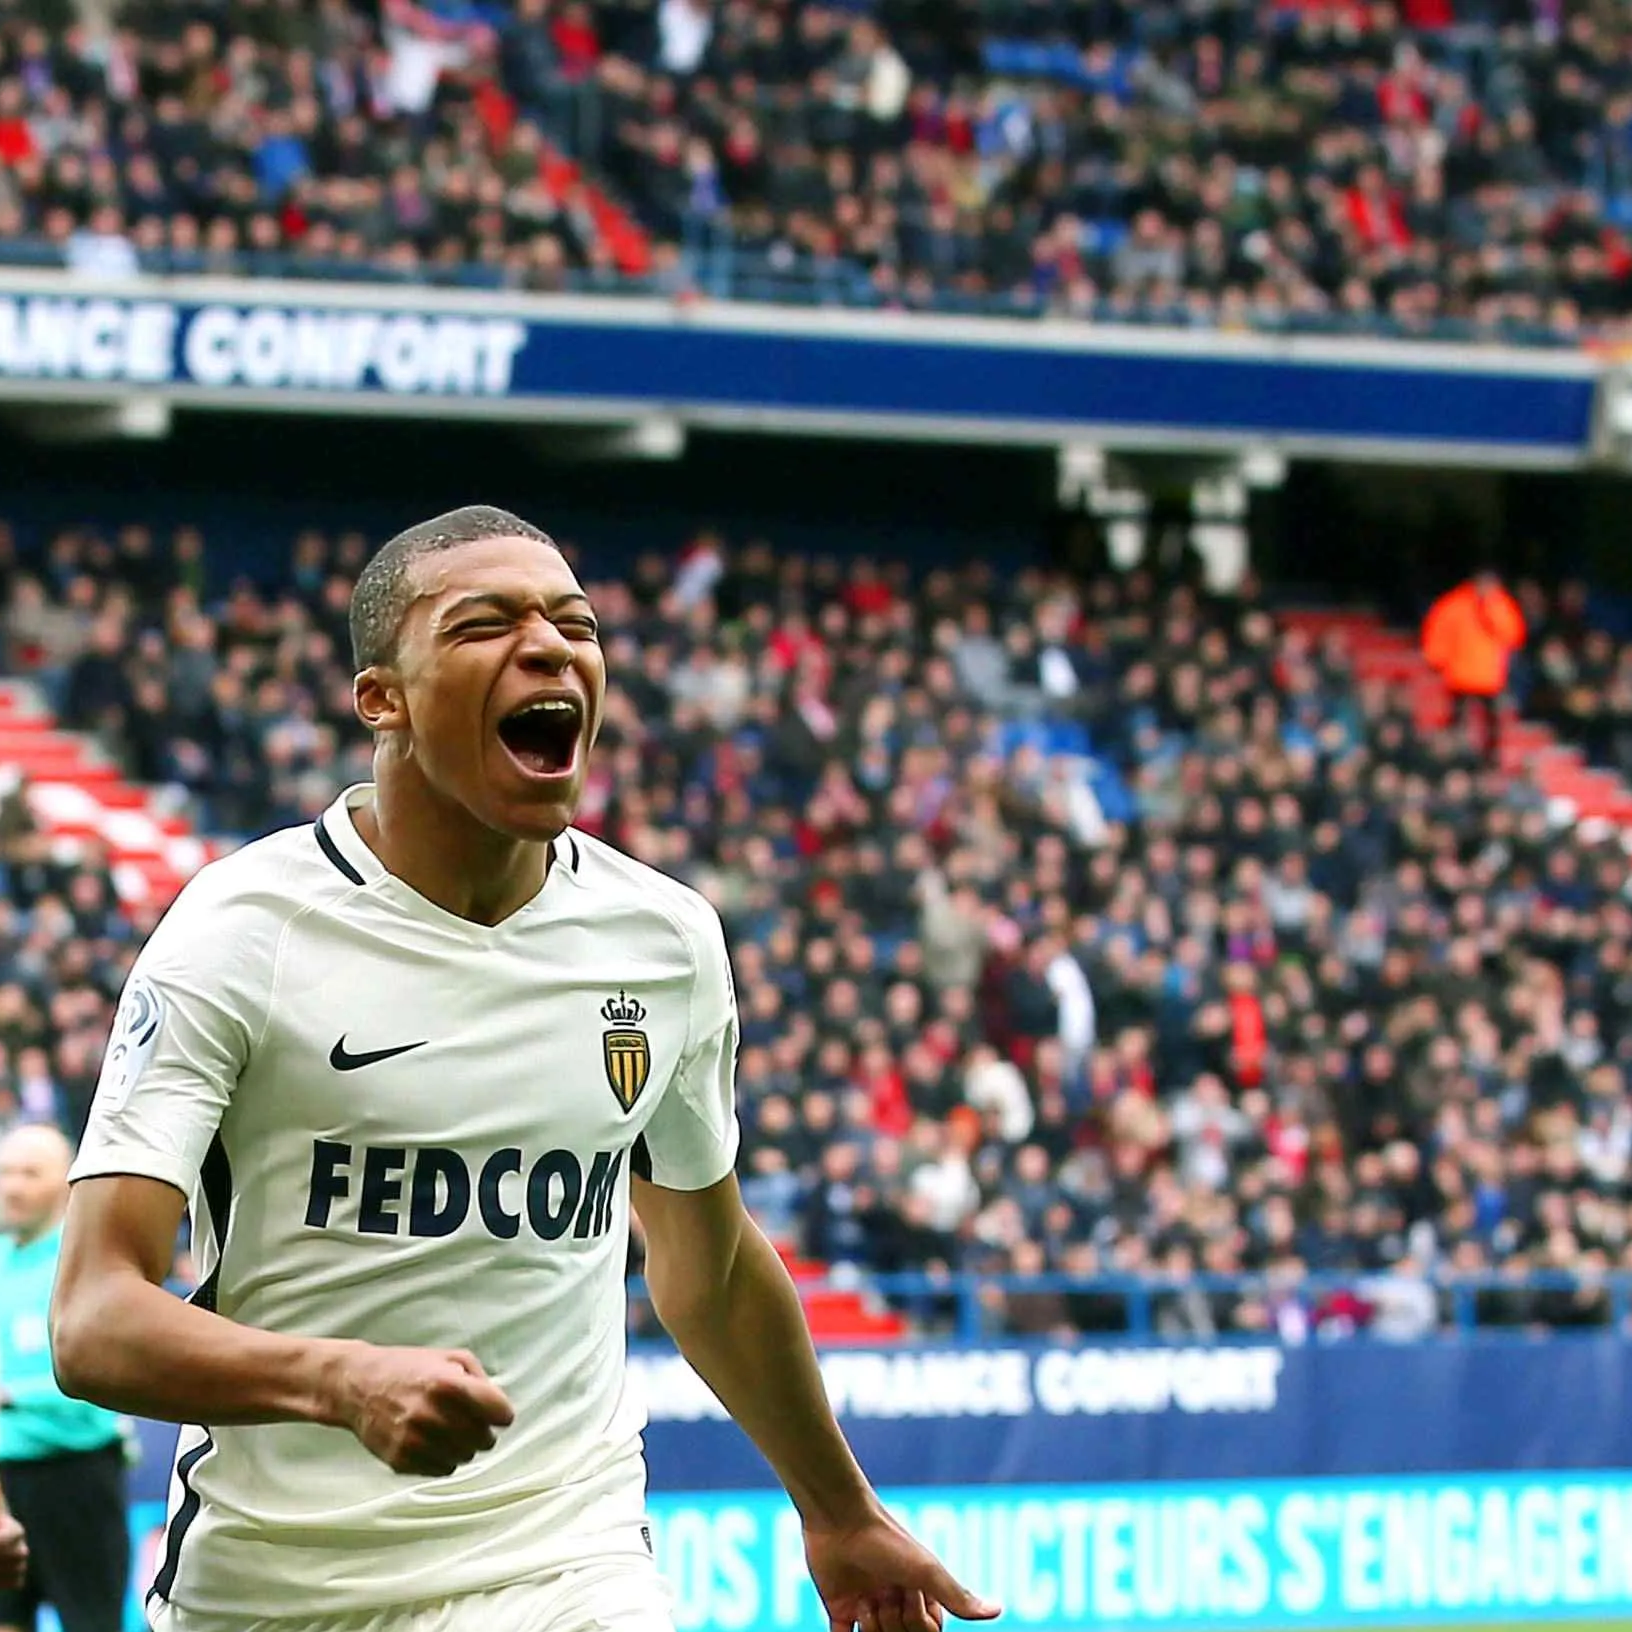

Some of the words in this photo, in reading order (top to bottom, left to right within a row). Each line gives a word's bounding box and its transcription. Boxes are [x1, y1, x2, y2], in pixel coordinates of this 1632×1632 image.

[184, 305, 525, 396] CONFORT
[304, 1138, 625, 1241] FEDCOM
[1034, 1345, 1282, 1415] CONFORT
[650, 1507, 760, 1630] OS
[772, 1494, 1267, 1627] PDUCTEURS
